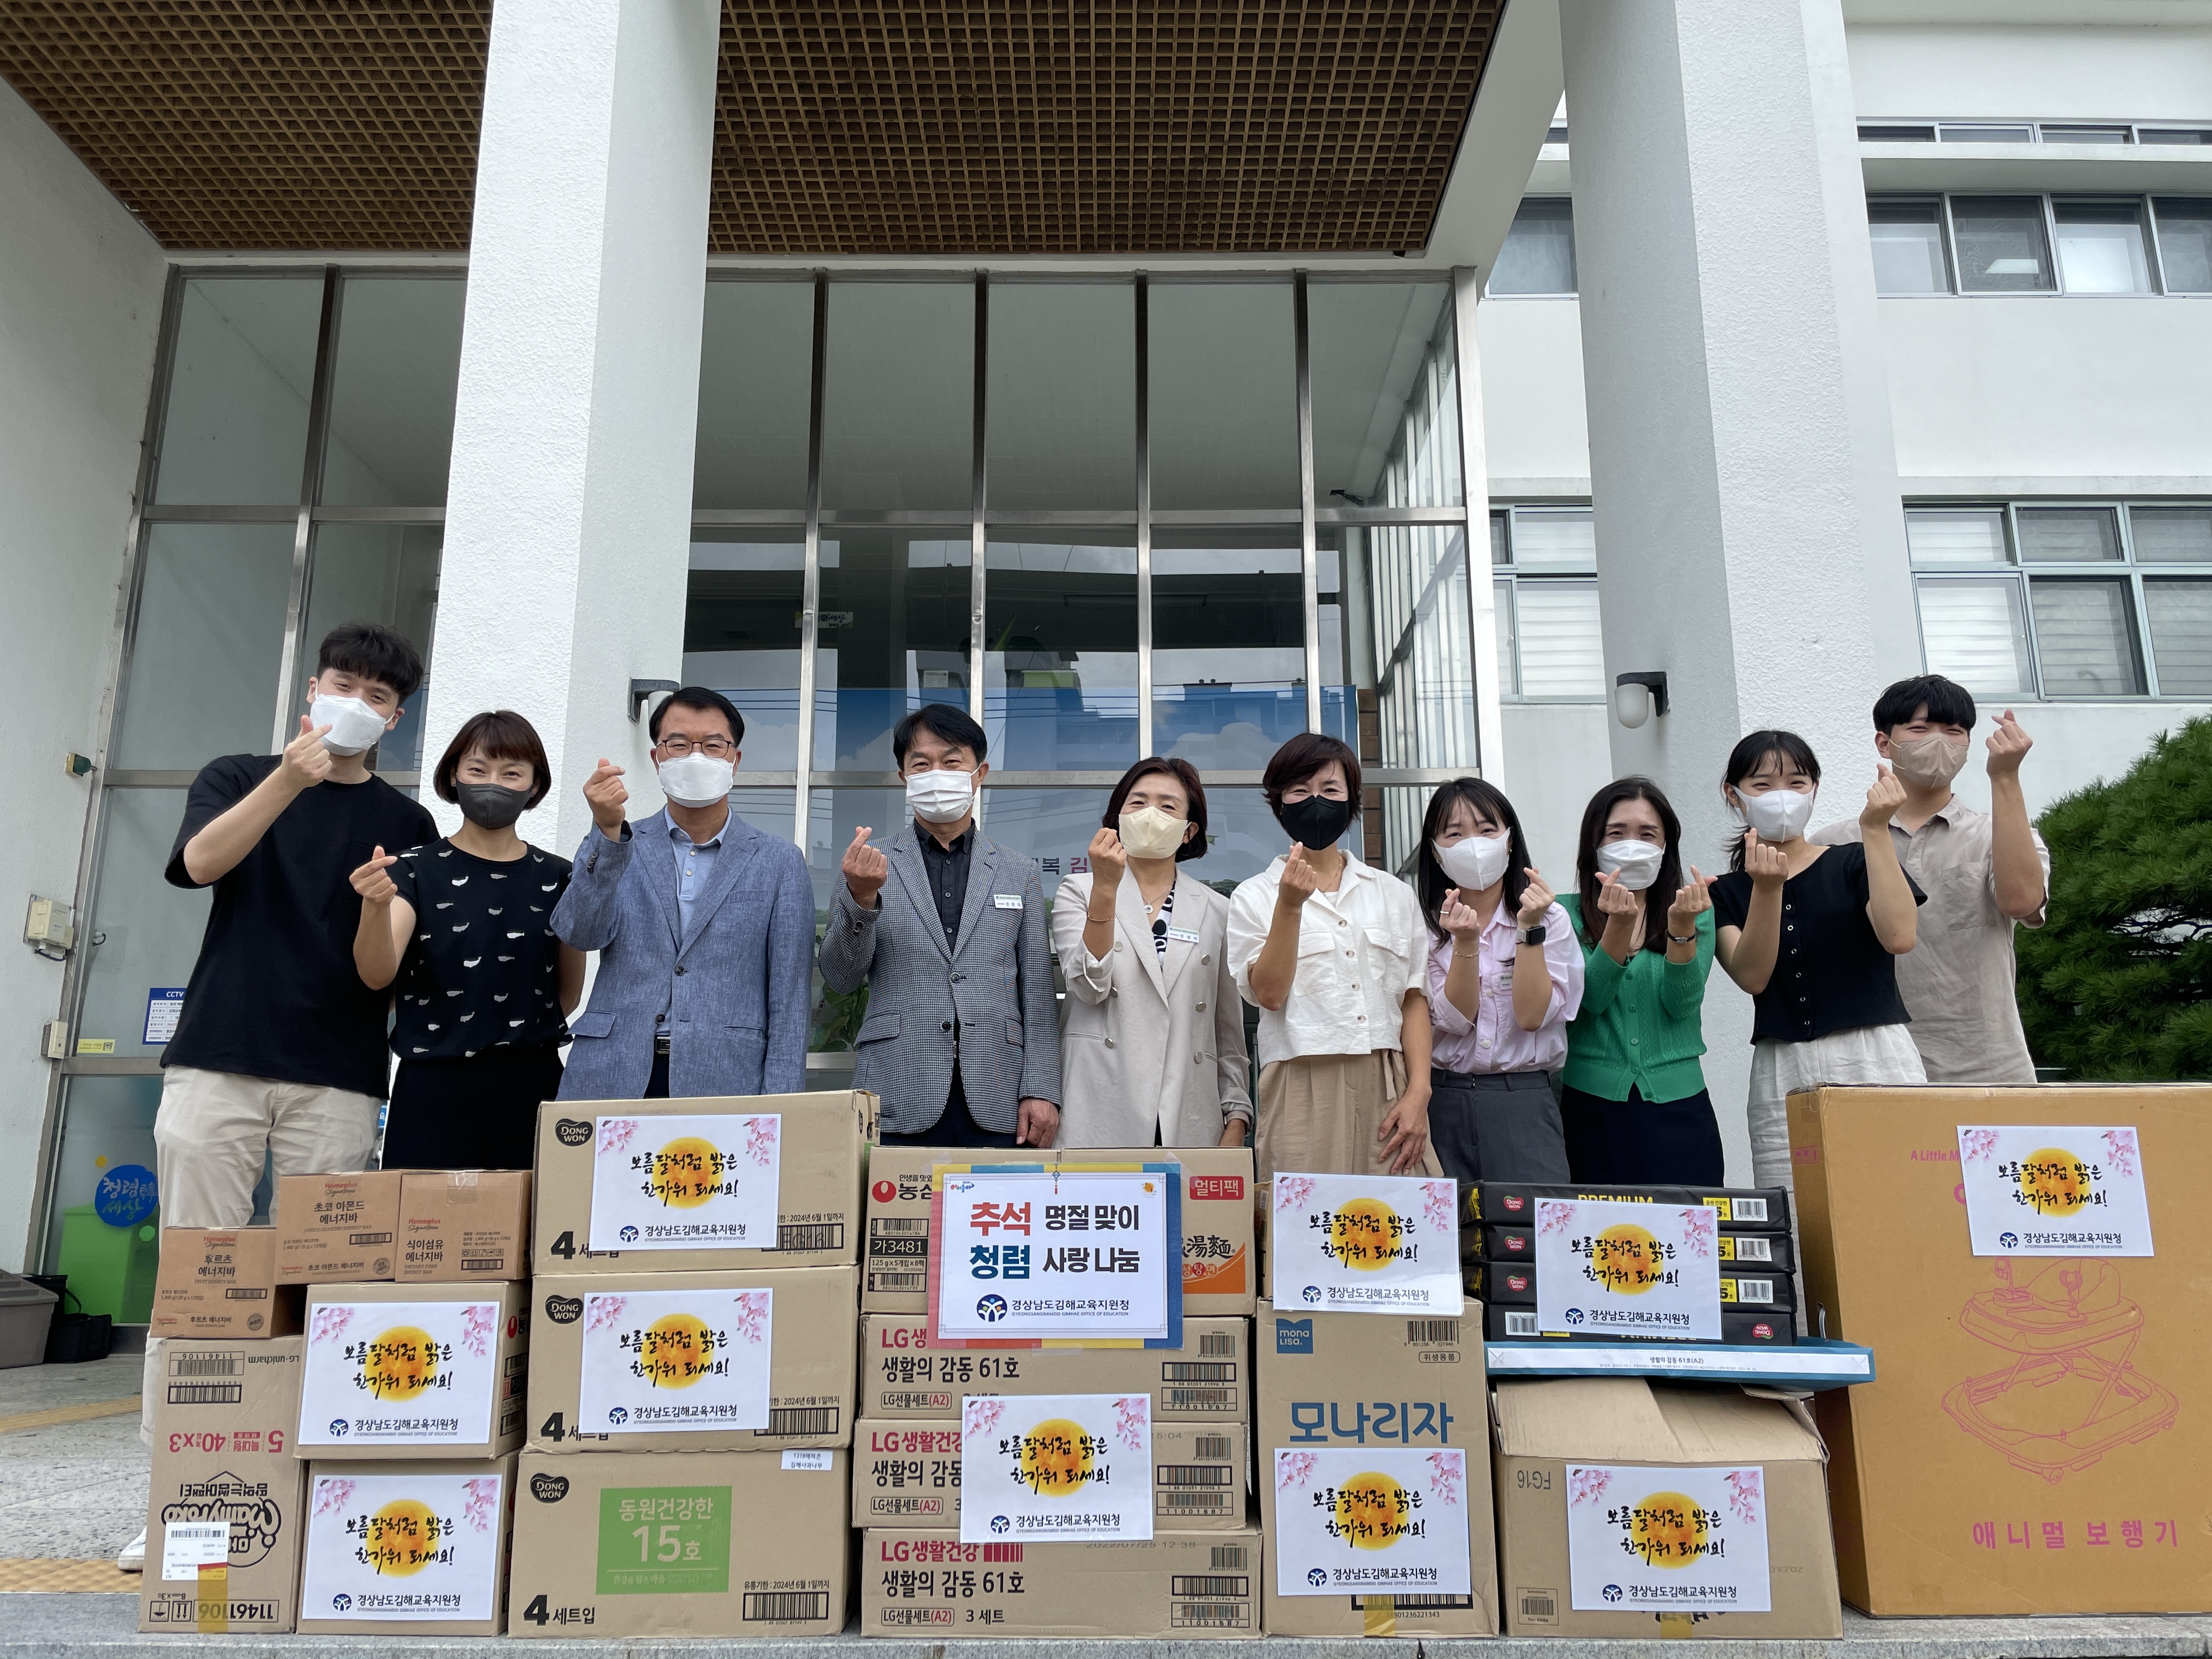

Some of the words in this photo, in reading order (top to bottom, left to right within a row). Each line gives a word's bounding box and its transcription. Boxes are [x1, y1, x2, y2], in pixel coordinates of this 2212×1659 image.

[560, 1126, 588, 1136] DONG
[630, 1152, 702, 1175] 보름달처럼
[709, 1152, 737, 1175] 밝은
[1910, 1150, 1918, 1161] A
[1920, 1150, 1947, 1161] Little
[1999, 1161, 2068, 1184] 보름달처럼
[2074, 1163, 2102, 1185] 밝은
[324, 1189, 356, 1197] Signature
[641, 1180, 687, 1207] 한가위
[693, 1178, 738, 1197] 되세요!
[1195, 1180, 1239, 1197] 멀티팩
[101, 1198, 144, 1220] 세상
[314, 1203, 333, 1212] 초코
[336, 1201, 365, 1212] 아몬드
[2012, 1188, 2058, 1215] 한가위
[2063, 1189, 2107, 1207] 되세요!
[320, 1213, 358, 1224] 에너지바
[790, 1214, 811, 1223] 2024년
[812, 1213, 821, 1222] 6월
[823, 1212, 844, 1222] 1일까지
[970, 1201, 1031, 1237] 추석
[1045, 1205, 1089, 1230] 명절
[1094, 1205, 1139, 1230] 맞이
[1309, 1211, 1380, 1236] 보름달처럼
[1387, 1215, 1415, 1238] 밝은
[408, 1224, 439, 1233] Signature
[645, 1224, 746, 1237] 경상남도김해교육지원청
[407, 1239, 444, 1250] 식이섬유
[874, 1240, 923, 1254] 가3481
[2023, 1232, 2121, 1244] 경상남도김해교육지원청
[405, 1251, 443, 1262] 에너지바
[1321, 1240, 1367, 1268] 한가위
[1373, 1243, 1418, 1262] 되세요!
[1571, 1236, 1641, 1260] 보름달처럼
[1648, 1240, 1676, 1263] 밝은
[204, 1254, 232, 1264] 후르츠
[969, 1244, 1030, 1279] 청렴
[1042, 1247, 1090, 1273] 사랑
[1094, 1247, 1139, 1273] 나눔
[198, 1266, 235, 1277] 에너지바
[1583, 1265, 1628, 1292] 한가위
[1635, 1267, 1679, 1287] 되세요!
[1328, 1287, 1429, 1301] 경상남도김해교육지원청
[551, 1303, 579, 1312] DONG
[1012, 1299, 1129, 1311] 경상남도김해교육지원청
[1590, 1310, 1689, 1325] 경상남도김해교육지원청
[619, 1330, 691, 1354] 보름달처럼
[699, 1329, 727, 1353] 밝은
[882, 1328, 909, 1348] LG
[248, 1355, 300, 1364] LG-unicharm
[343, 1341, 416, 1366] 보름달처럼
[424, 1342, 452, 1366] 밝은
[630, 1359, 676, 1387] 한가위
[684, 1357, 729, 1377] 되세요!
[882, 1357, 932, 1383] 생활의
[940, 1357, 974, 1383] 감동
[979, 1357, 1020, 1378] 61호
[353, 1371, 399, 1400] 한가위
[407, 1370, 453, 1390] 되세요!
[784, 1397, 805, 1406] 2024년
[806, 1396, 816, 1406] 6월
[818, 1396, 839, 1405] 1일까지
[883, 1393, 949, 1408] LG선물세트(A2)
[634, 1405, 737, 1419] 경상남도김해교육지원청
[355, 1419, 458, 1431] 경상남도김해교육지원청
[1290, 1402, 1454, 1444] 모나리자
[233, 1441, 259, 1452] 특대형
[268, 1430, 284, 1453] 5
[871, 1432, 899, 1453] LG
[998, 1435, 1071, 1460] 보름달처럼
[1079, 1435, 1108, 1460] 밝은
[871, 1460, 923, 1487] 생활의
[1010, 1465, 1057, 1495] 한가위
[1064, 1464, 1110, 1485] 되세요!
[1517, 1470, 1551, 1489] FG16
[180, 1483, 268, 1497] 땀먹는썸머팬티
[535, 1481, 565, 1491] DONG
[539, 1490, 561, 1499] WON
[618, 1497, 714, 1522] 동원건강한
[873, 1499, 940, 1514] LG선물세트(A2)
[1313, 1487, 1386, 1514] 보름달처럼
[1393, 1488, 1423, 1514] 밝은
[345, 1515, 418, 1541] 보름달처럼
[426, 1515, 454, 1541] 밝은
[1016, 1514, 1120, 1527] 경상남도김해교육지원청
[1607, 1506, 1684, 1532] 보름달처럼
[1692, 1509, 1722, 1533] 밝은
[1325, 1518, 1373, 1548] 한가위
[1380, 1518, 1425, 1539] 되세요!
[1973, 1521, 2066, 1550] 애니멀
[2086, 1519, 2177, 1549] 보행기
[632, 1525, 702, 1562] 15호
[881, 1541, 909, 1562] LG
[912, 1541, 979, 1562] 생활건강
[1620, 1537, 1670, 1566] 한가위
[1677, 1538, 1725, 1558] 되세요!
[354, 1545, 401, 1575] 한가위
[409, 1545, 455, 1566] 되세요!
[1333, 1567, 1437, 1581] 경상남도김해교육지원청
[773, 1580, 794, 1589] 2024년
[795, 1579, 806, 1589] 6월
[808, 1579, 830, 1589] 1일까지
[882, 1570, 934, 1598] 생활의
[941, 1570, 977, 1598] 감동
[983, 1572, 1025, 1594] 61호
[1629, 1585, 1736, 1598] 경상남도김해교육지원청
[357, 1594, 460, 1607] 경상남도김해교육지원청
[198, 1603, 273, 1620] 11461106
[523, 1594, 550, 1626] 4
[552, 1606, 595, 1625] 세트입
[883, 1610, 952, 1624] LG선물세트(A2)
[966, 1610, 974, 1622] 3
[979, 1610, 1005, 1625] 세트
